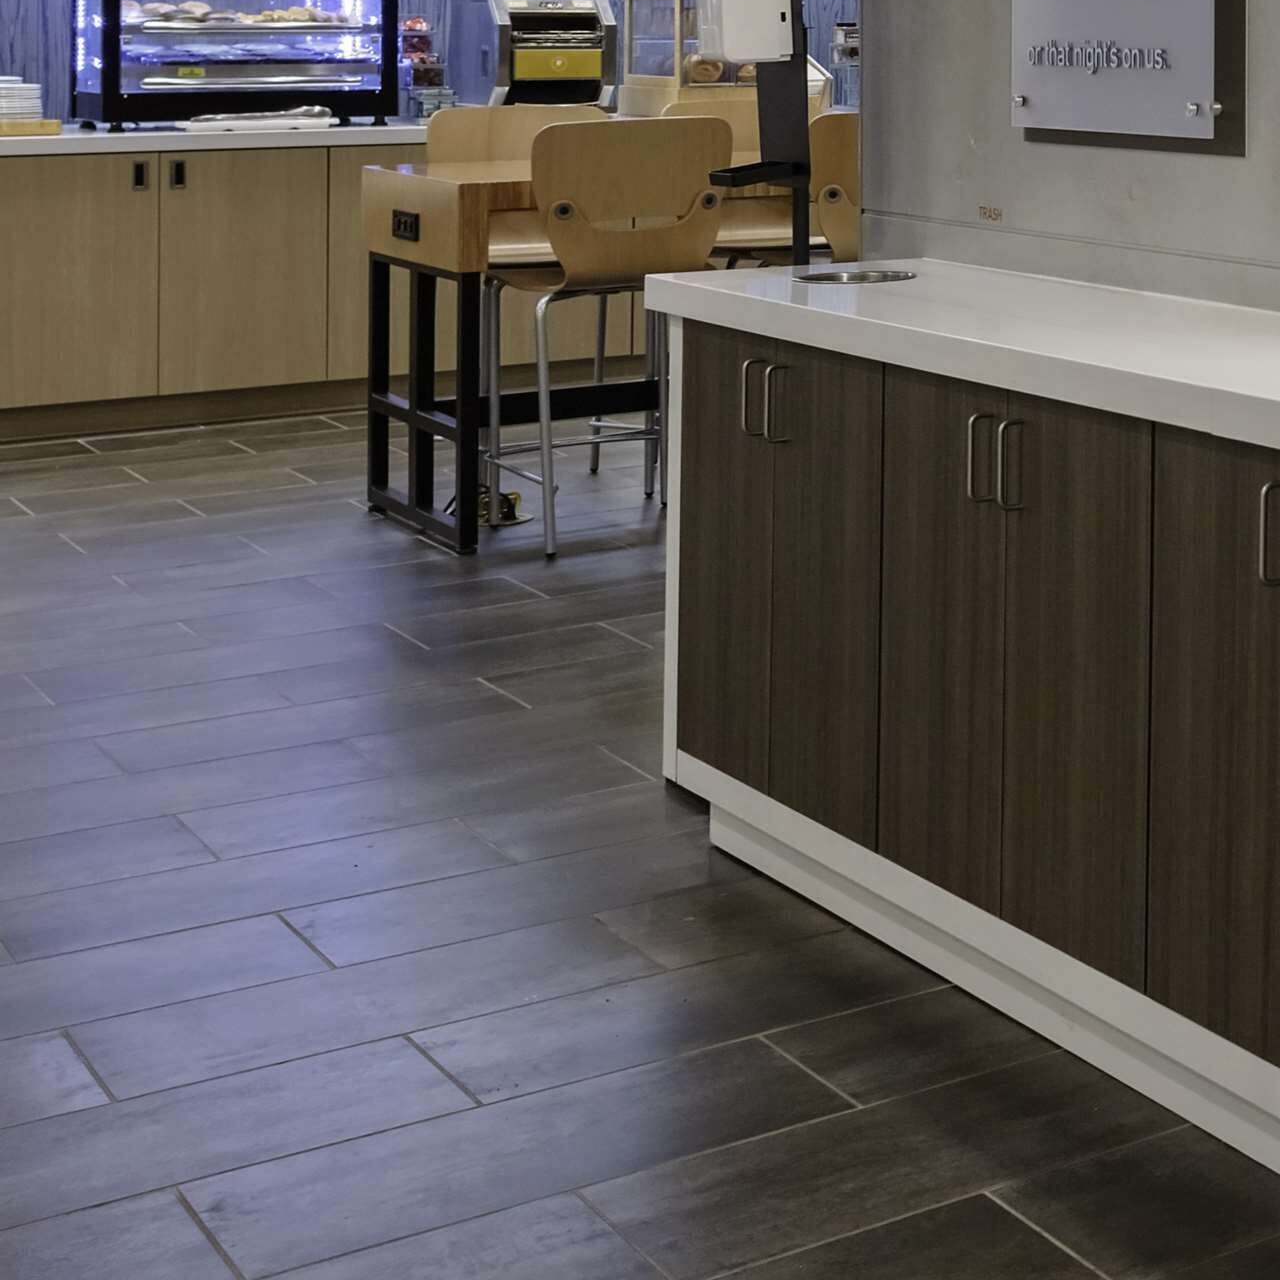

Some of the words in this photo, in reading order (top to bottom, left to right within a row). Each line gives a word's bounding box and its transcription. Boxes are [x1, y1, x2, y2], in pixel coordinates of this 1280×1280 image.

[1027, 44, 1043, 66] or
[1046, 40, 1073, 66] that
[1075, 39, 1119, 74] night's
[1123, 46, 1144, 68] on
[1146, 47, 1170, 70] us.
[978, 206, 1003, 221] TRASH
